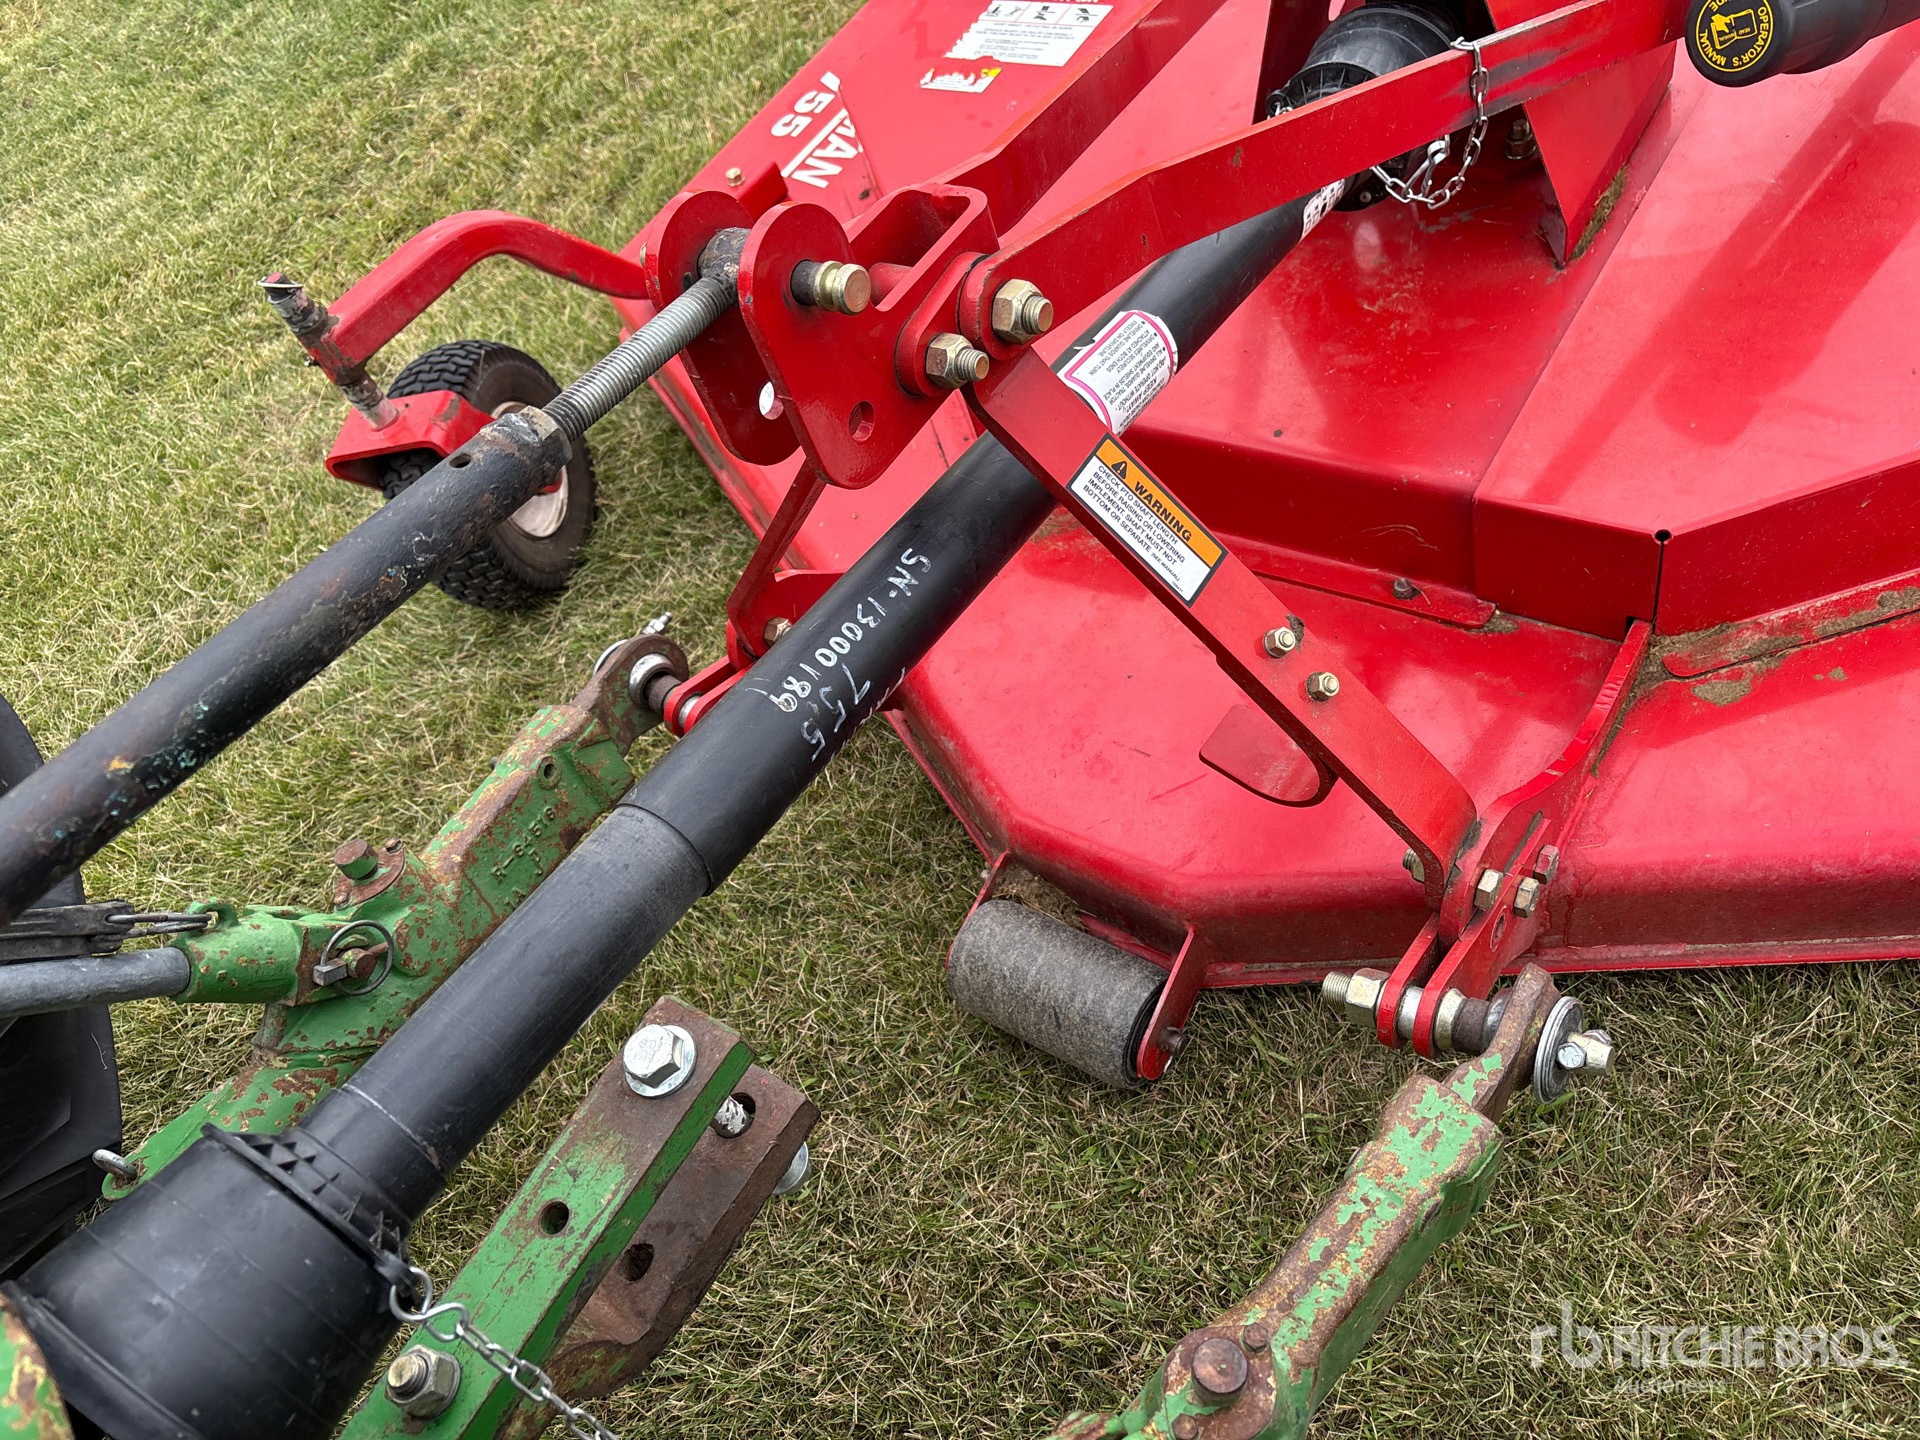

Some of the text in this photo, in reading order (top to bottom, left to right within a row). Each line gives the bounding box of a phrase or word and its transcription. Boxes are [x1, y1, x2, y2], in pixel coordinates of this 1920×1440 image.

[1709, 0, 1731, 12] DE
[1699, 7, 1769, 66] OPERATOR'S MANUAL
[1122, 319, 1137, 334] FREELY
[1097, 337, 1119, 358] DRIVELINE
[1130, 328, 1150, 349] ATTACHED
[1088, 323, 1143, 376] DRIVELINE GUARDS THAT TURN
[1115, 350, 1128, 363] BOTH
[1105, 360, 1118, 373] ENDS
[1115, 353, 1136, 374] SECURELY
[1139, 354, 1157, 374] DRIVELINE
[1097, 465, 1178, 545] CHECK PTO SHAFT LENGTH
[1133, 480, 1193, 542] WARNING
[1082, 484, 1111, 513] BOTTOM
[1109, 510, 1121, 523] OR
[1119, 520, 1152, 553] SEPARATE
[1087, 477, 1177, 566] IMPLEMENT. SHAFT MUST NOT
[1092, 471, 1186, 564] BEFORE RAISING OR LOWERING
